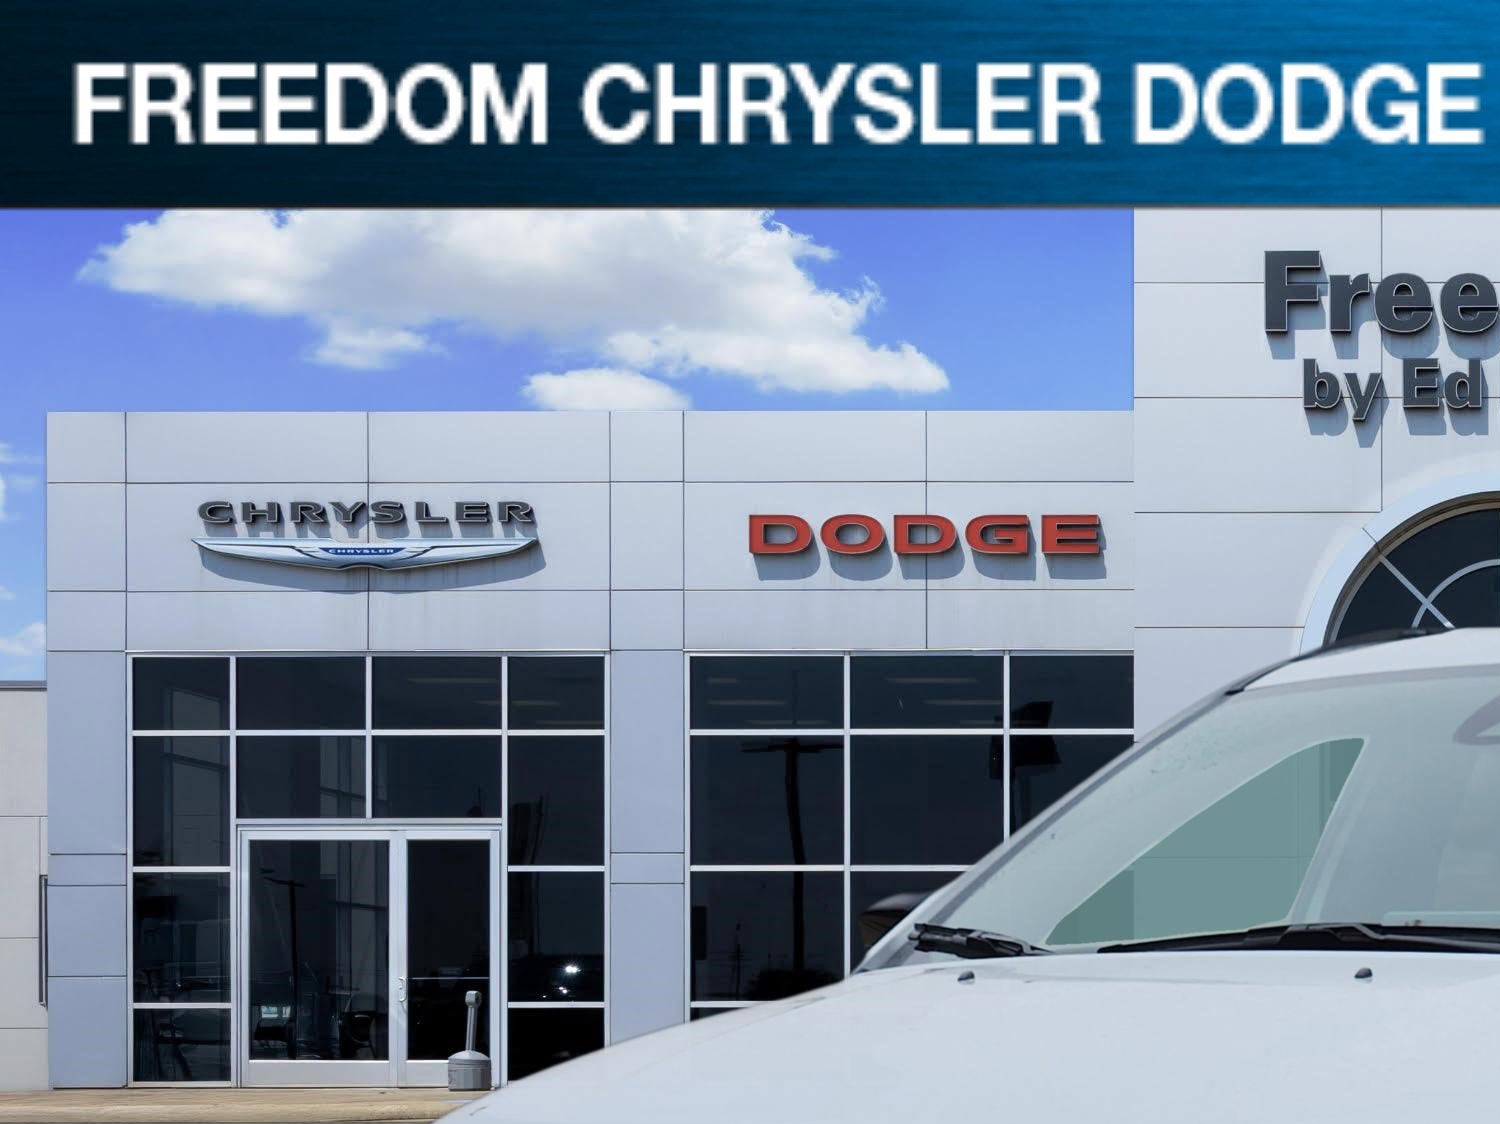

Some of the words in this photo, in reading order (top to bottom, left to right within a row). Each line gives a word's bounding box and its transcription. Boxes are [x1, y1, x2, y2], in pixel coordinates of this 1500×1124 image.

[1303, 358, 1382, 421] by
[1402, 358, 1482, 408] Ed
[198, 501, 535, 524] CHRYSLER
[749, 514, 1101, 555] DODGE
[328, 547, 396, 556] CHRYSLER
